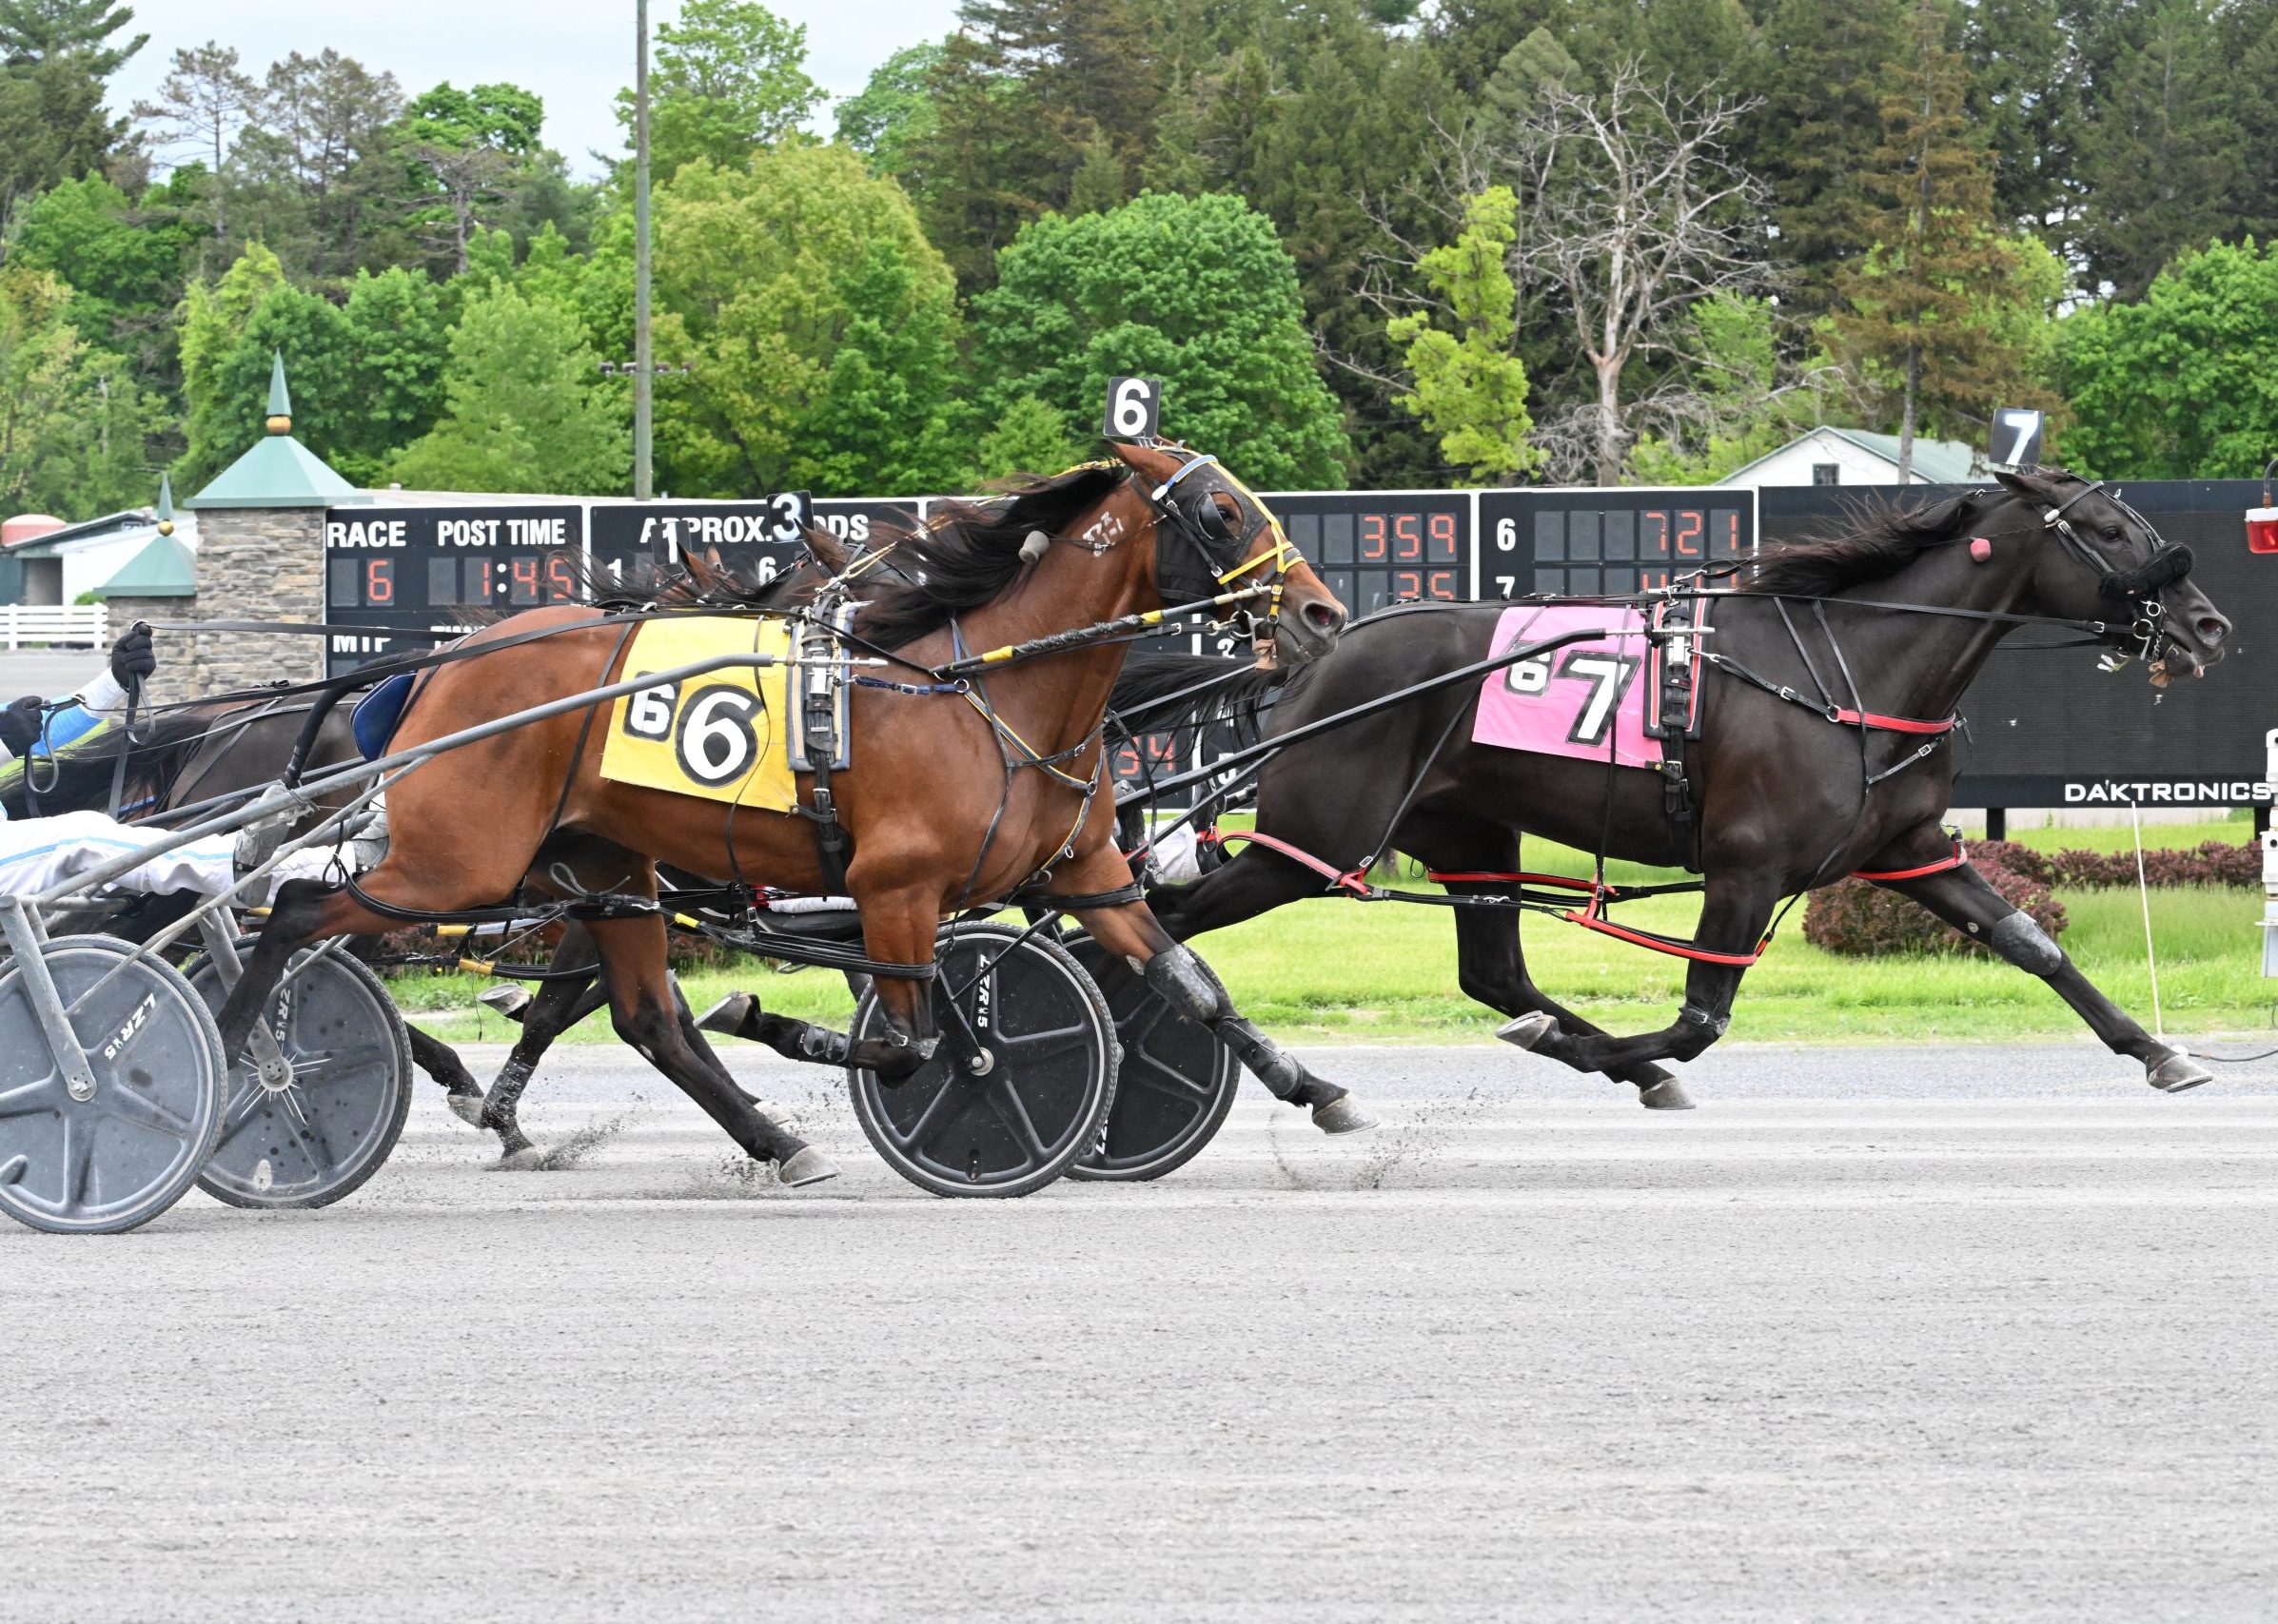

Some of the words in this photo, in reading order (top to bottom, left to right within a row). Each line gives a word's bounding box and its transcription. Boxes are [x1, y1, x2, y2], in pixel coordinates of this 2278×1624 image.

[1113, 379, 1150, 436] 6
[2003, 412, 2039, 466] 7
[327, 520, 406, 548] RACE
[438, 520, 501, 547] POST
[506, 519, 565, 545] TIME
[772, 493, 801, 541] 3
[1364, 515, 1455, 558] 359
[1497, 518, 1516, 552] 6
[1646, 512, 1738, 555] 721
[368, 559, 392, 601] 6
[483, 558, 572, 599] 1:45
[758, 556, 776, 586] 6
[1509, 646, 1551, 692] 6
[1569, 658, 1630, 740] 7
[630, 683, 676, 734] 6
[683, 692, 752, 779] 6
[2064, 781, 2270, 802] DAKTRONICS
